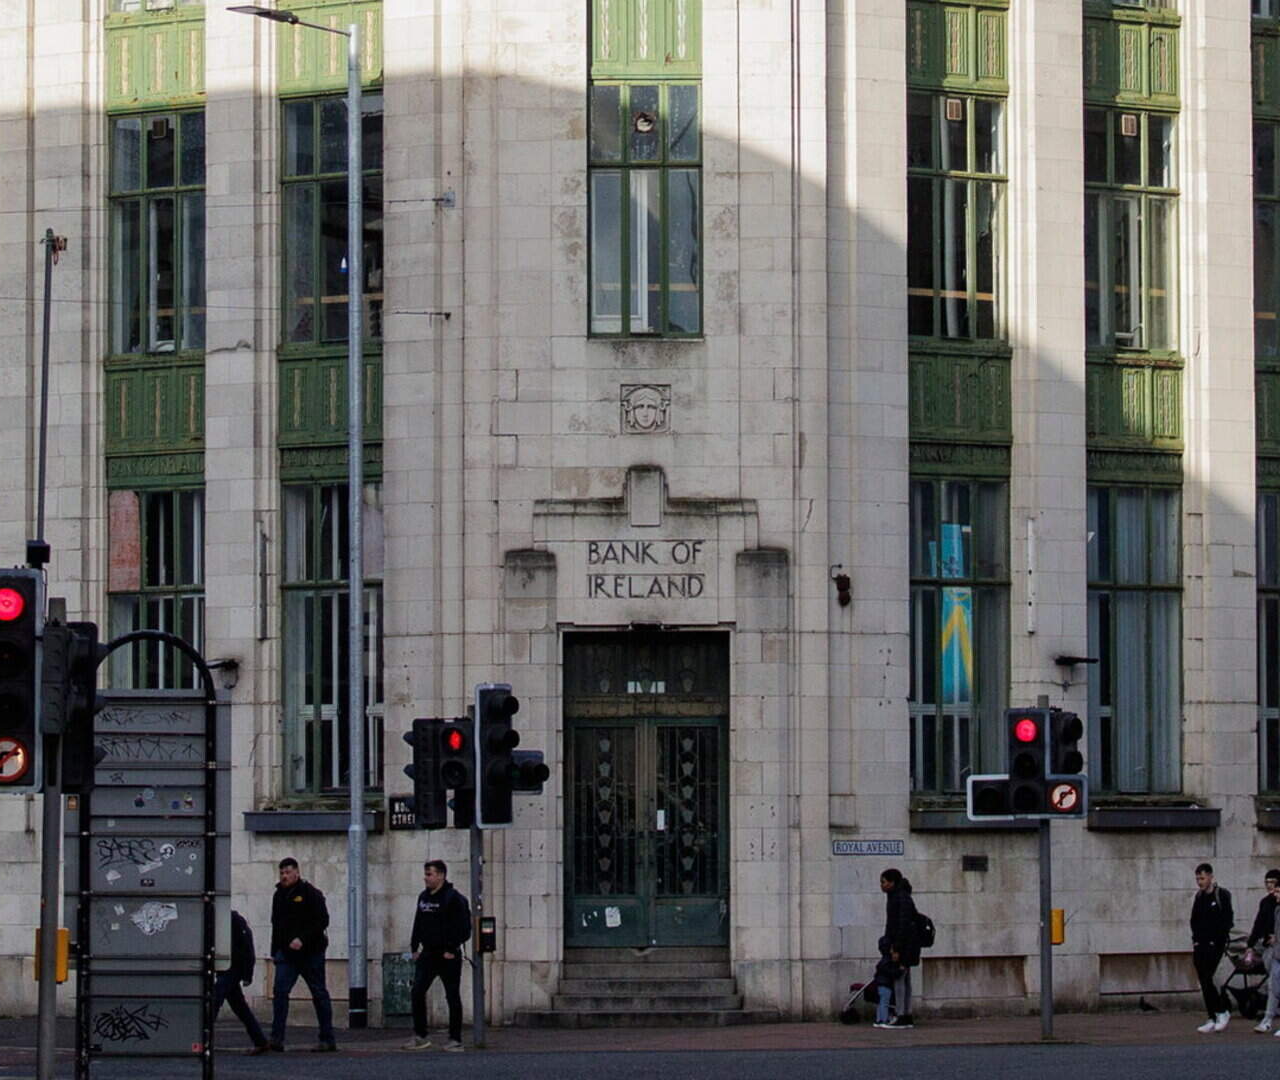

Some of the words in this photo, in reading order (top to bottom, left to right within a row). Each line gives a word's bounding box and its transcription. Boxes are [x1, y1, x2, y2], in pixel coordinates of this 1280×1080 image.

[588, 541, 658, 564] BANK
[671, 541, 703, 565] OF
[588, 576, 704, 599] IRELAND
[392, 813, 416, 825] STRE
[836, 842, 864, 853] ROYAL
[866, 842, 901, 853] AVENUE
